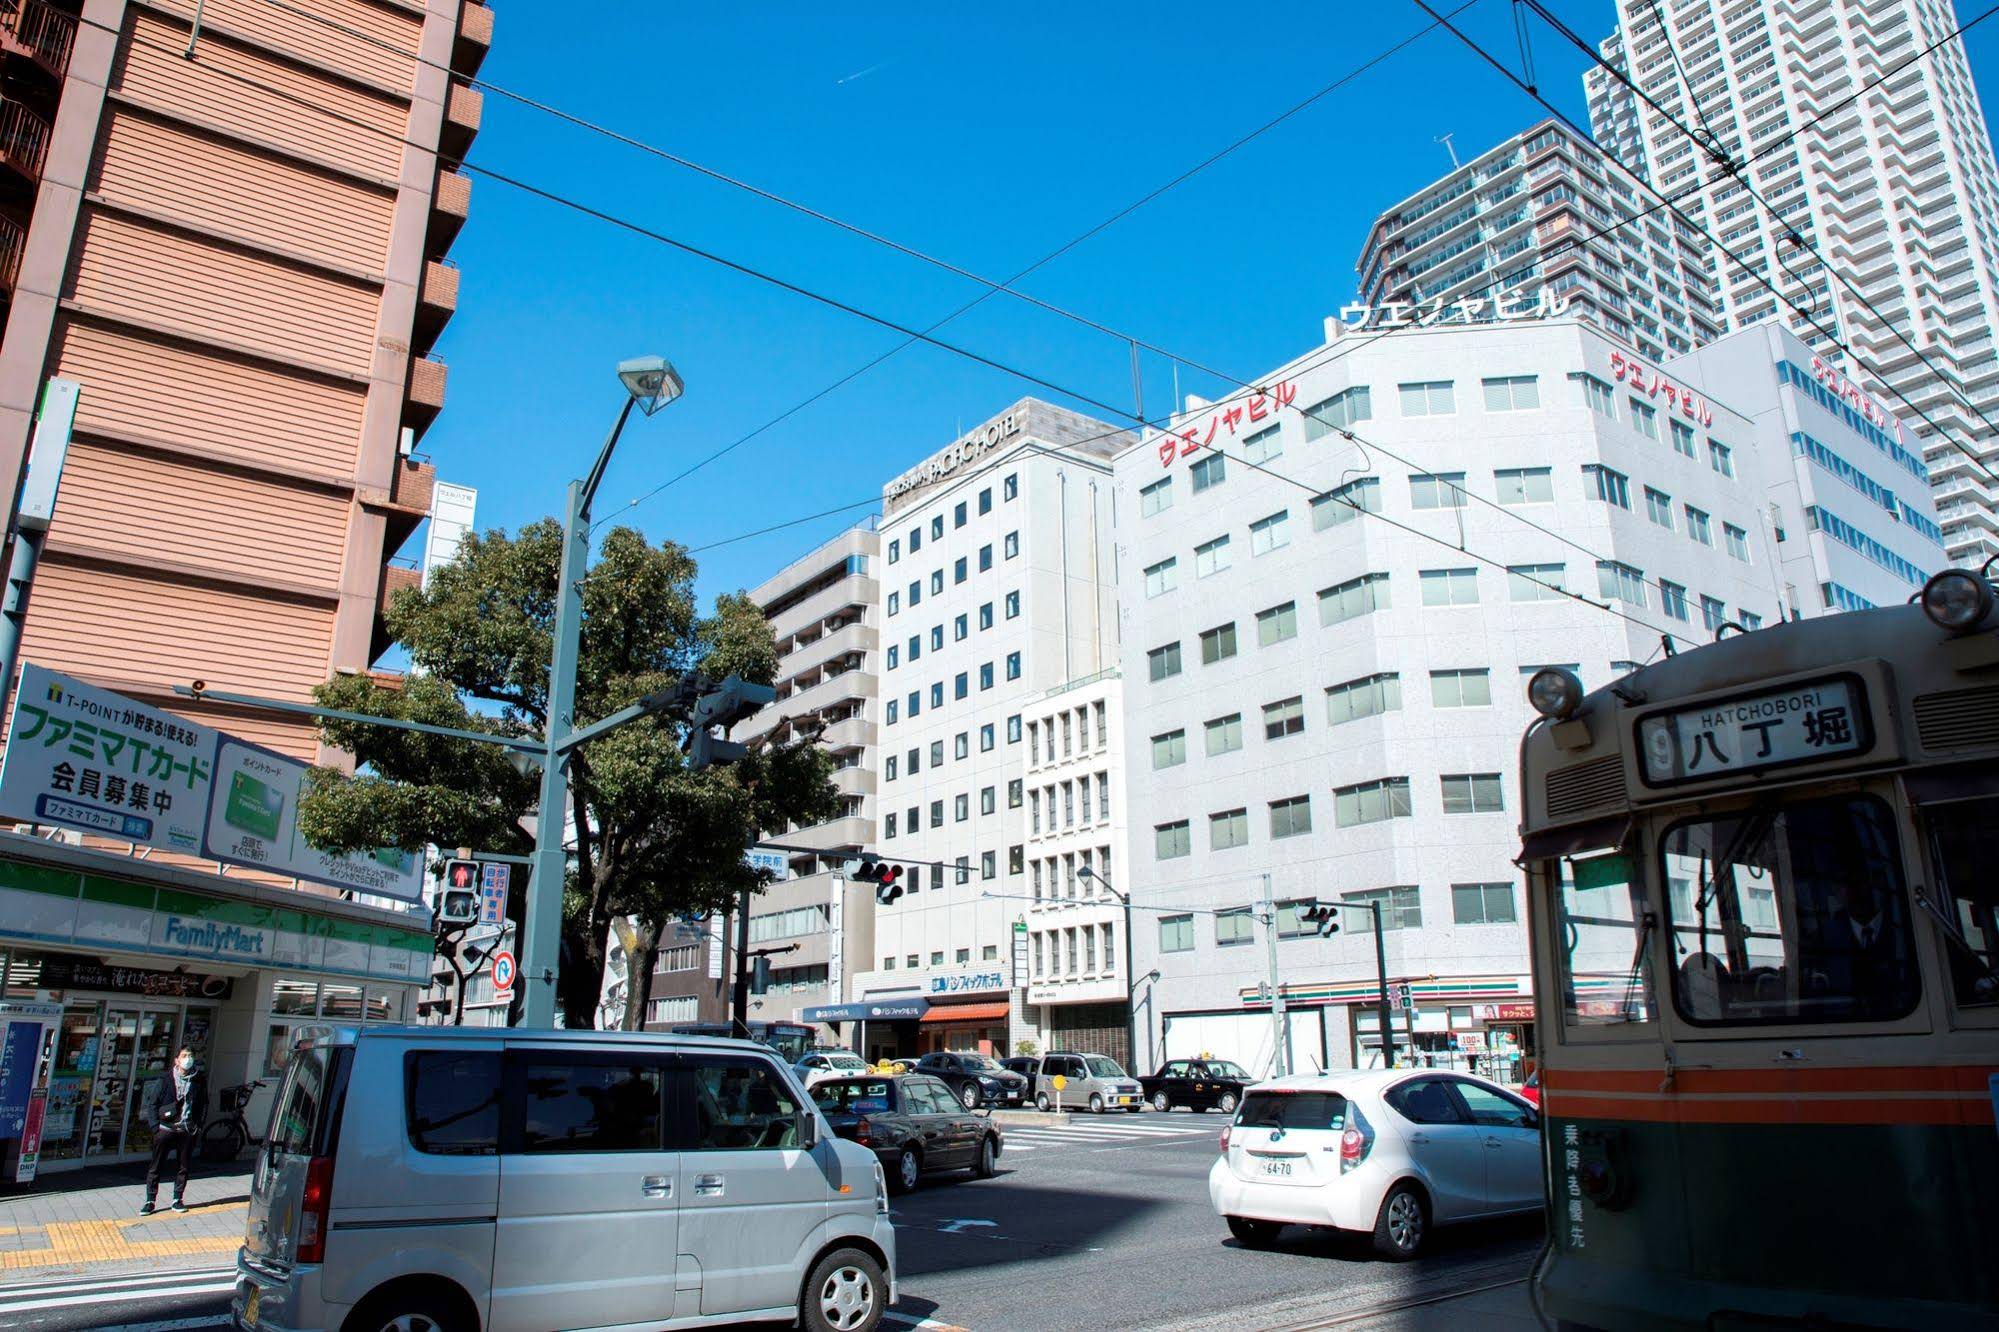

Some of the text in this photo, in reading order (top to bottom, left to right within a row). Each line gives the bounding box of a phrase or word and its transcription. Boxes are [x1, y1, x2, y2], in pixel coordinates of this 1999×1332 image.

[1342, 288, 1569, 333] ウエノヤビル
[1610, 351, 1713, 428] ウエノヤビル
[929, 441, 975, 484] PACIFIC
[975, 412, 1020, 456] HOTEL
[1158, 380, 1298, 468] ウエノヤビル
[1700, 691, 1824, 729] HATCHOBORI
[18, 702, 210, 790] ファミマTカード
[1688, 707, 1852, 770] 八丁堀
[51, 762, 173, 816] 会員募集中
[243, 757, 283, 776] ポイントカード
[50, 803, 119, 827] ファミマTカード
[164, 917, 264, 955] FamilyMart
[1267, 1162, 1292, 1175] 64-70
